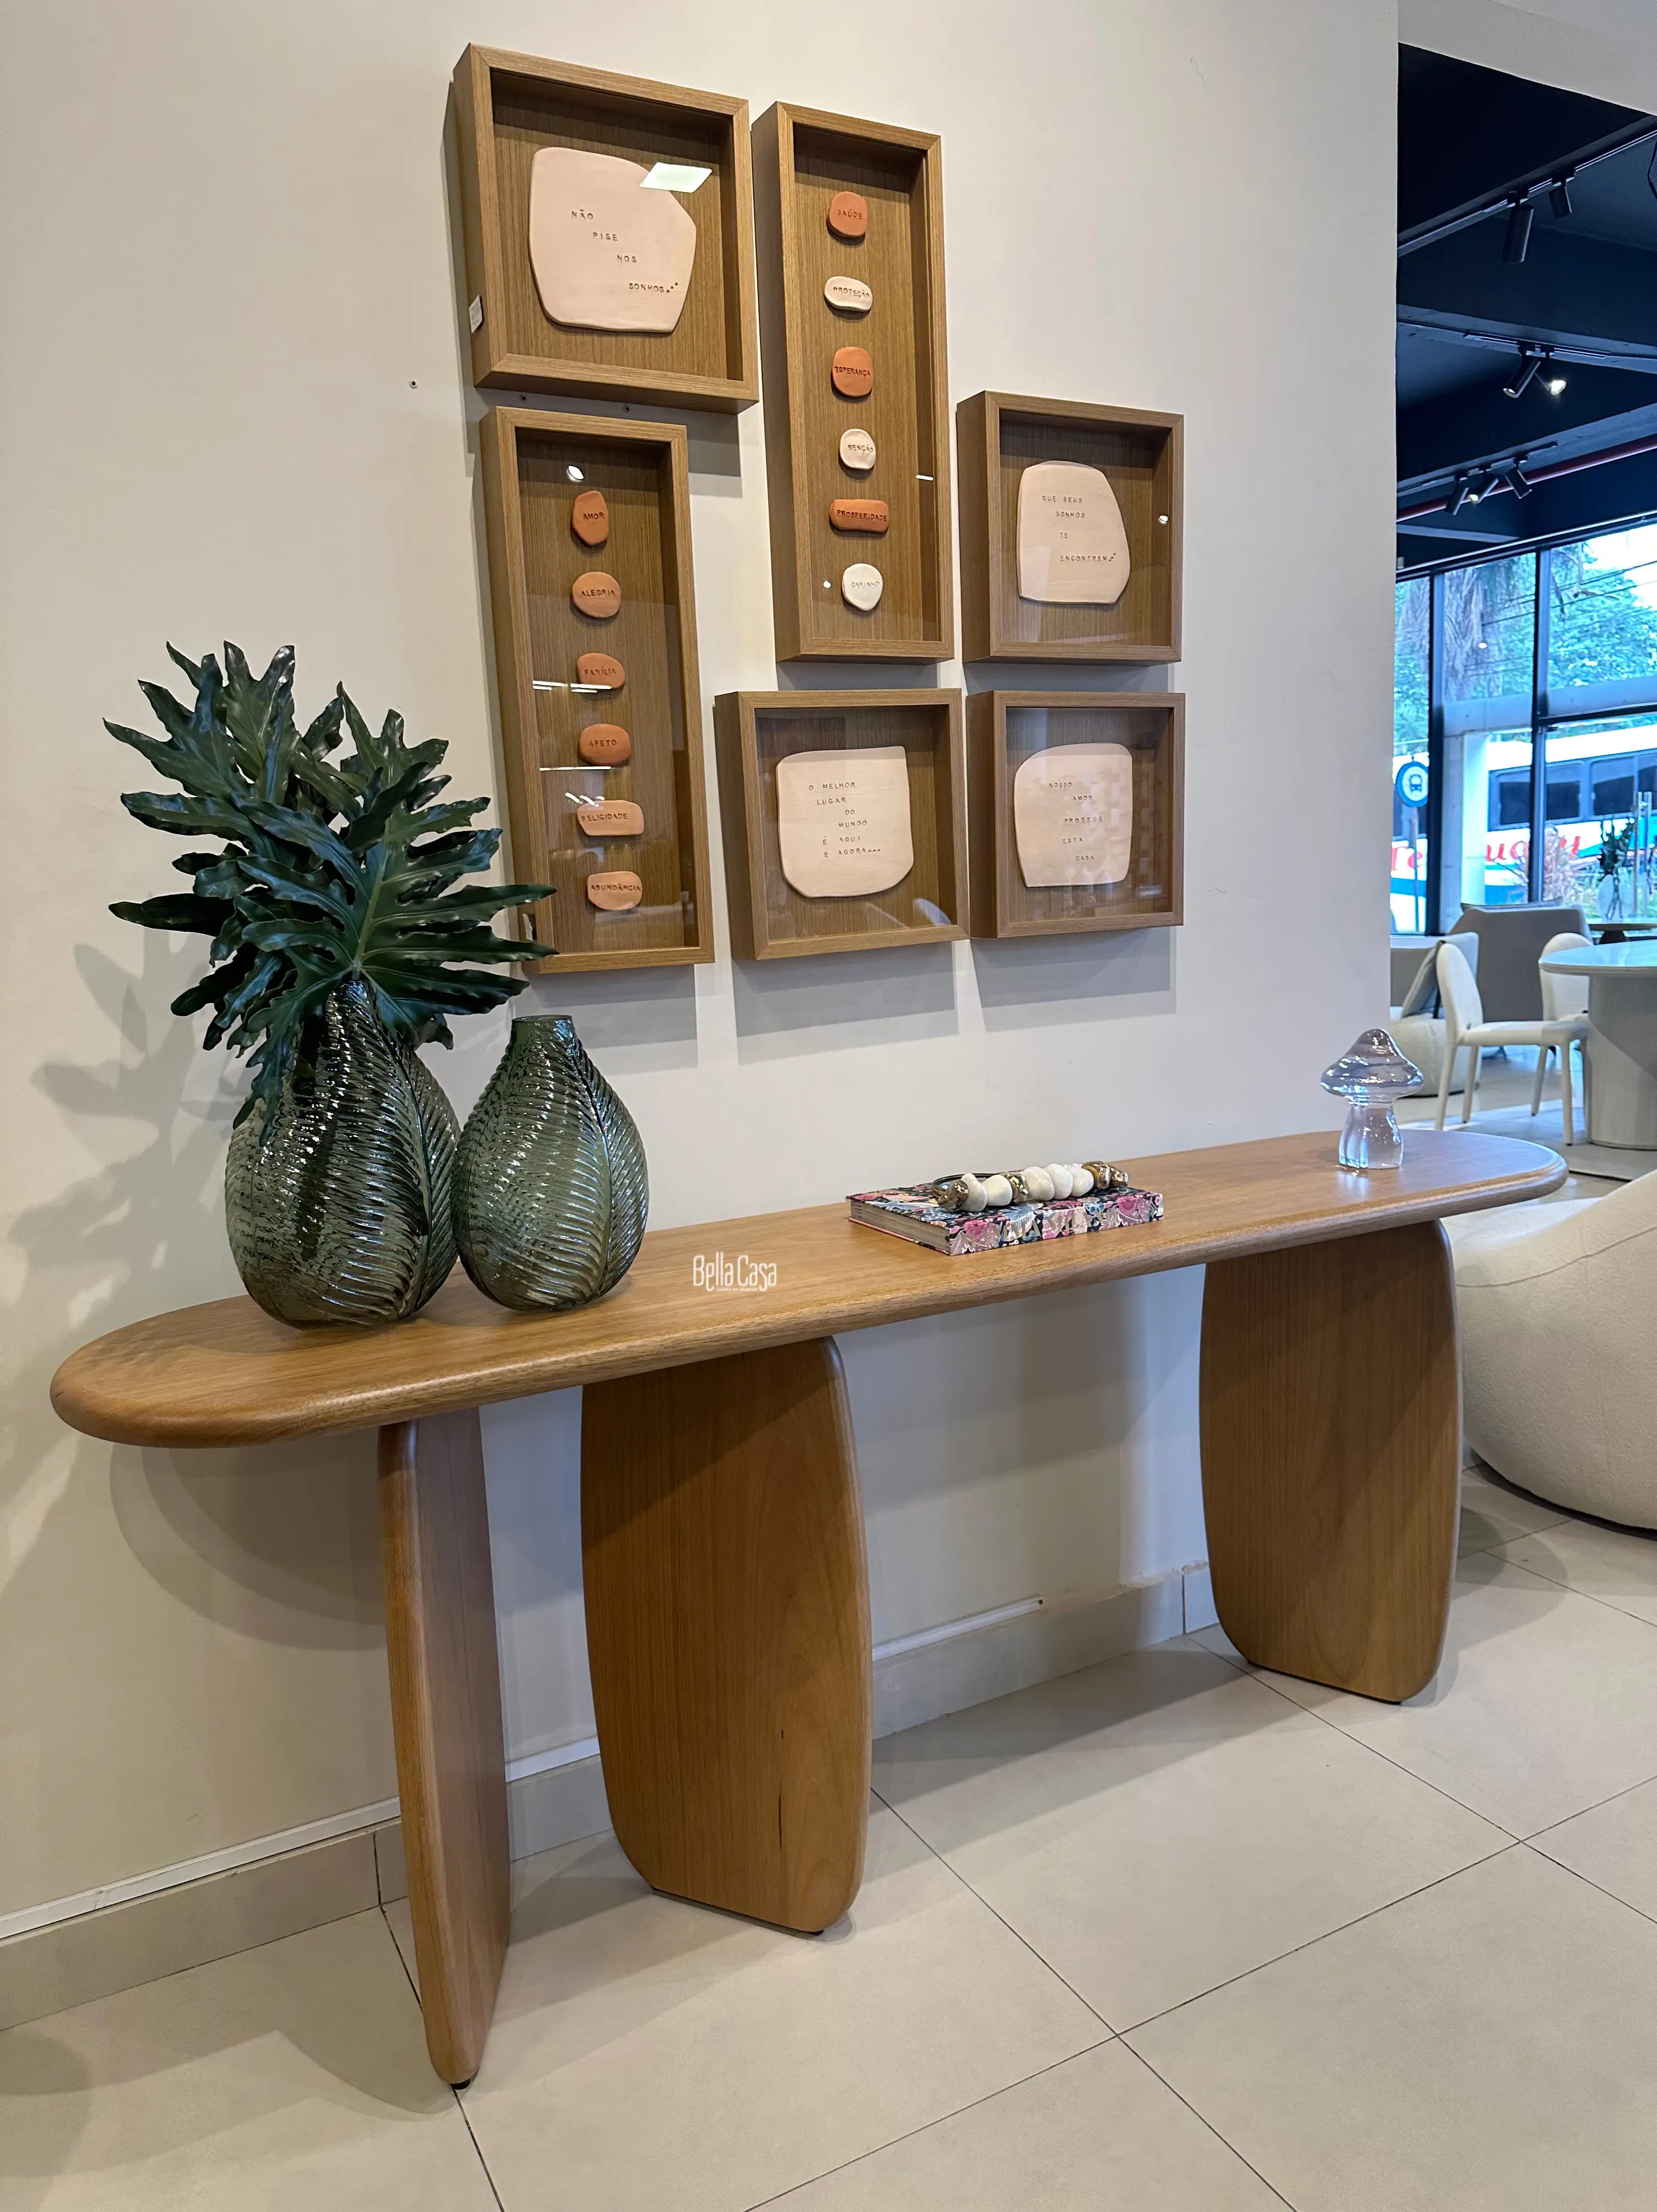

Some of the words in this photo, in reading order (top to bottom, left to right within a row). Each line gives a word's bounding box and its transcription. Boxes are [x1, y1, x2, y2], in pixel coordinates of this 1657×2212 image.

[571, 209, 594, 219] NÃO
[837, 209, 863, 220] SAÚDE
[593, 232, 618, 241] PISE
[617, 254, 637, 263] NOS
[833, 286, 870, 300] PROTEÇÃO
[834, 366, 871, 377] ESPERANÇA
[847, 444, 873, 454] BENÇÃO
[583, 512, 605, 520] AMOR
[837, 509, 887, 522] PROSPERIDADE
[580, 589, 616, 597] ALEGRIA
[583, 665, 617, 676] FAMÍLIA
[588, 739, 617, 748] AFETO
[822, 782, 856, 790] MELHOR
[816, 797, 847, 805] LUGAR
[580, 812, 628, 822] FELICIDADE
[838, 820, 867, 828] MUNDO
[590, 883, 641, 892] ABUNDÂNCIA
